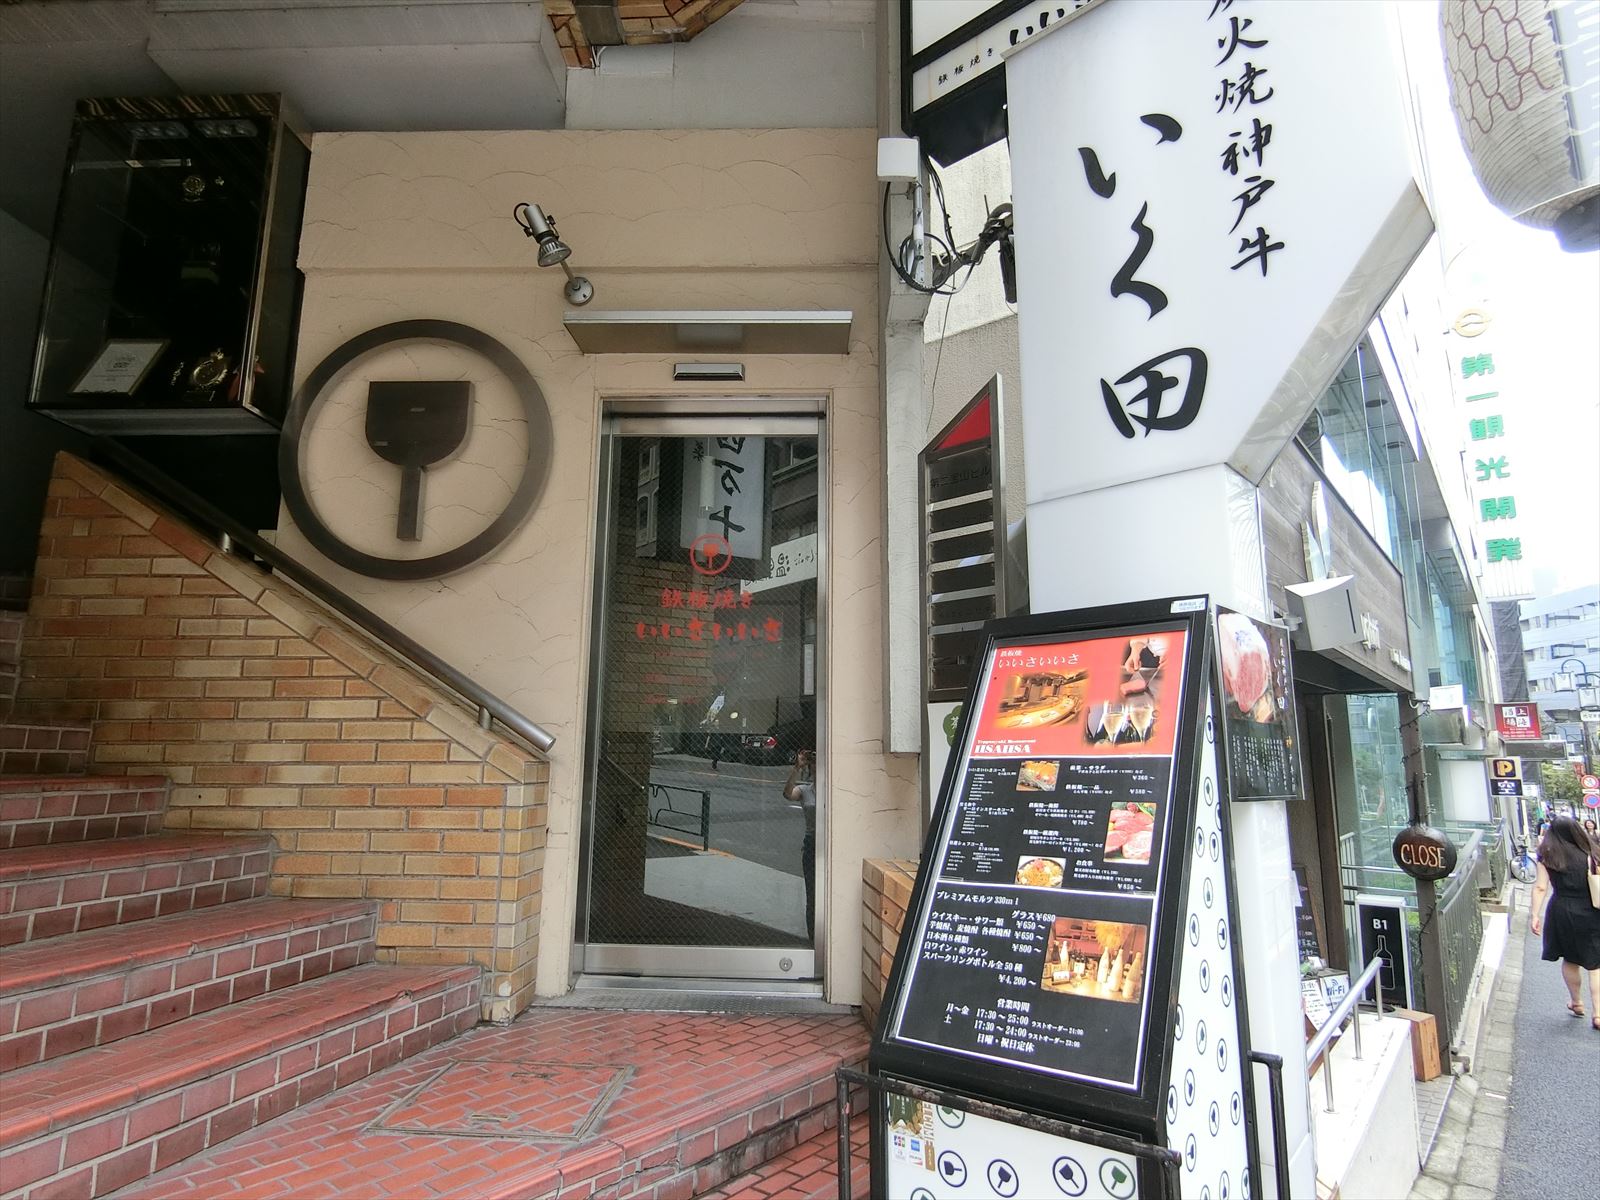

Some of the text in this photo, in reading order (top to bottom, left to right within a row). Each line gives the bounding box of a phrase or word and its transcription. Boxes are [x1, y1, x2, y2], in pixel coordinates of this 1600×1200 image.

[938, 47, 994, 86] 鉄板焼き
[1077, 112, 1208, 440] いく田
[660, 588, 752, 608] 鉄板焼き
[998, 653, 1079, 668] いいさいいさ
[1497, 781, 1516, 795] 空
[1400, 843, 1446, 871] CLOSE
[1372, 918, 1388, 931] B1
[997, 998, 1030, 1013] 営業時間
[943, 1015, 952, 1024] 土
[976, 1033, 1035, 1053] 日曜・祝日定休
